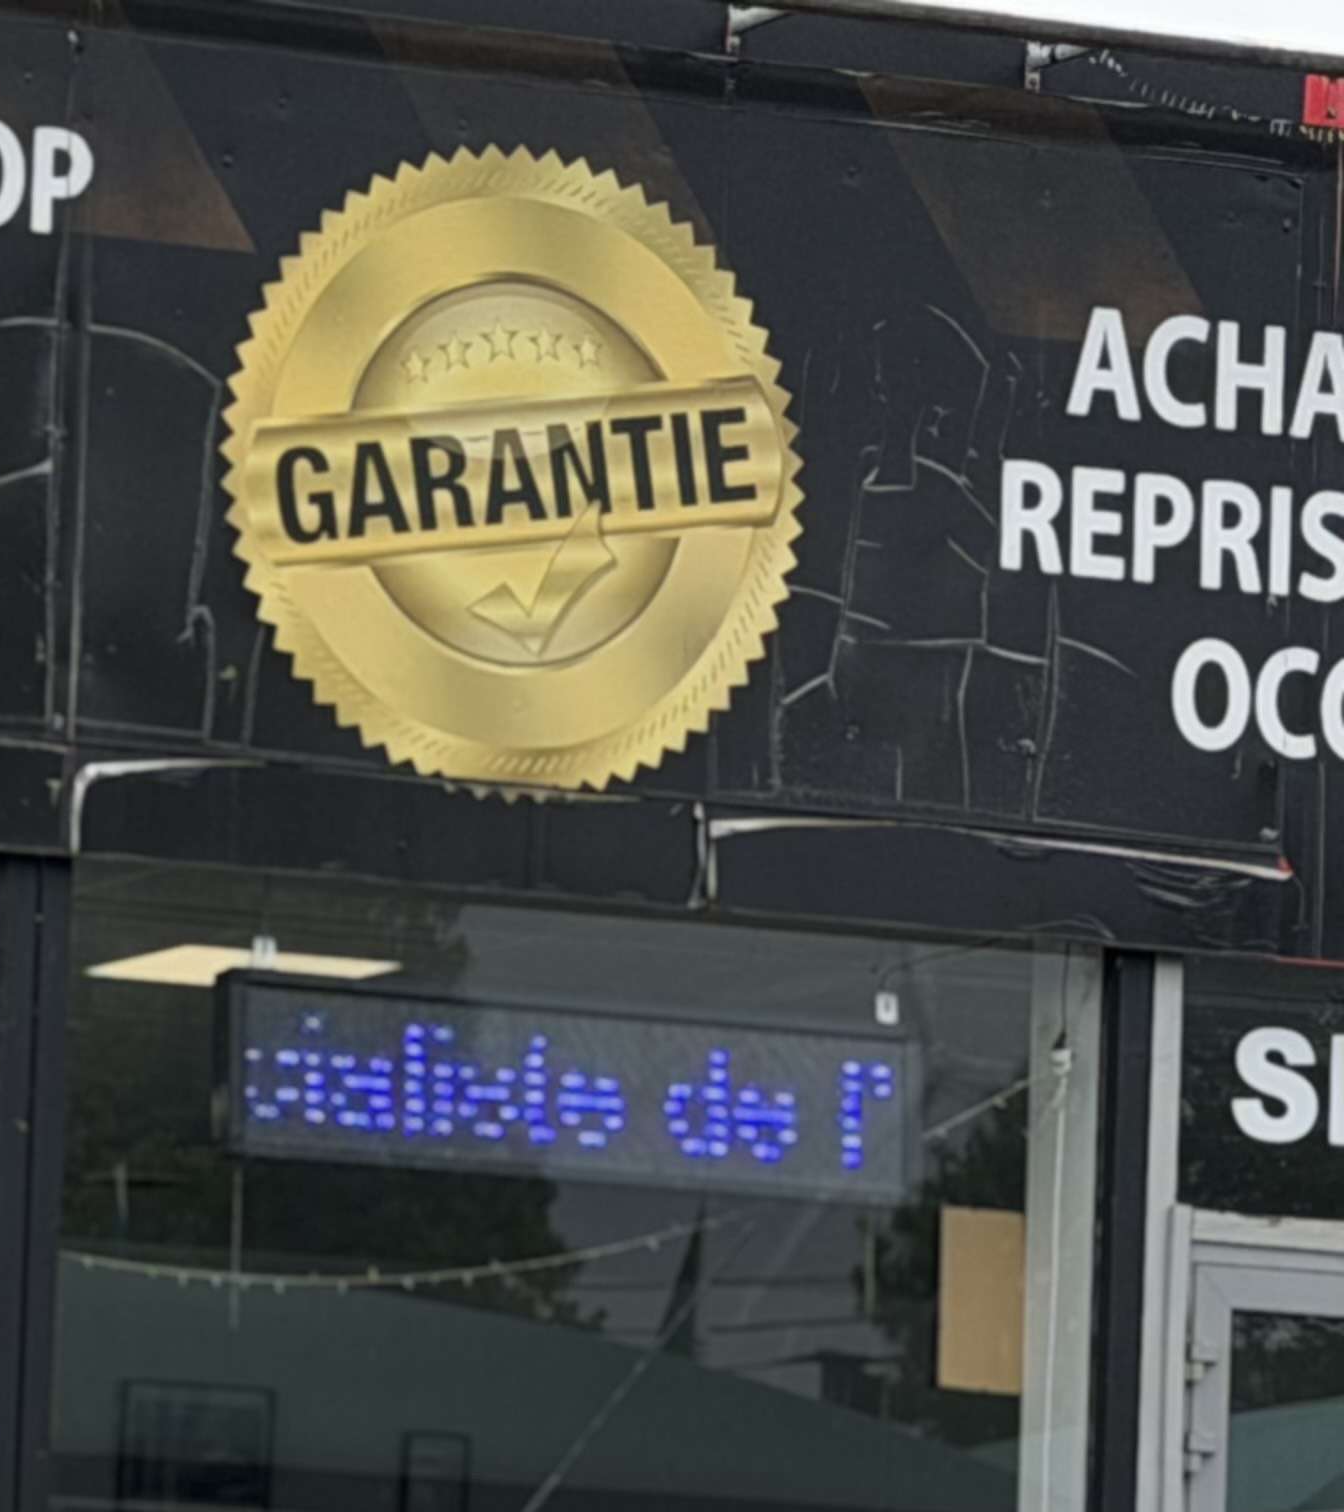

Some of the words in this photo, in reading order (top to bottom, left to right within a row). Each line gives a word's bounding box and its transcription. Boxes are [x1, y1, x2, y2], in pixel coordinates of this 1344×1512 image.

[1066, 307, 1344, 442] ACHA
[275, 405, 758, 546] GARANTIE
[1000, 459, 1344, 602] REPRIS
[1231, 1026, 1344, 1147] S
